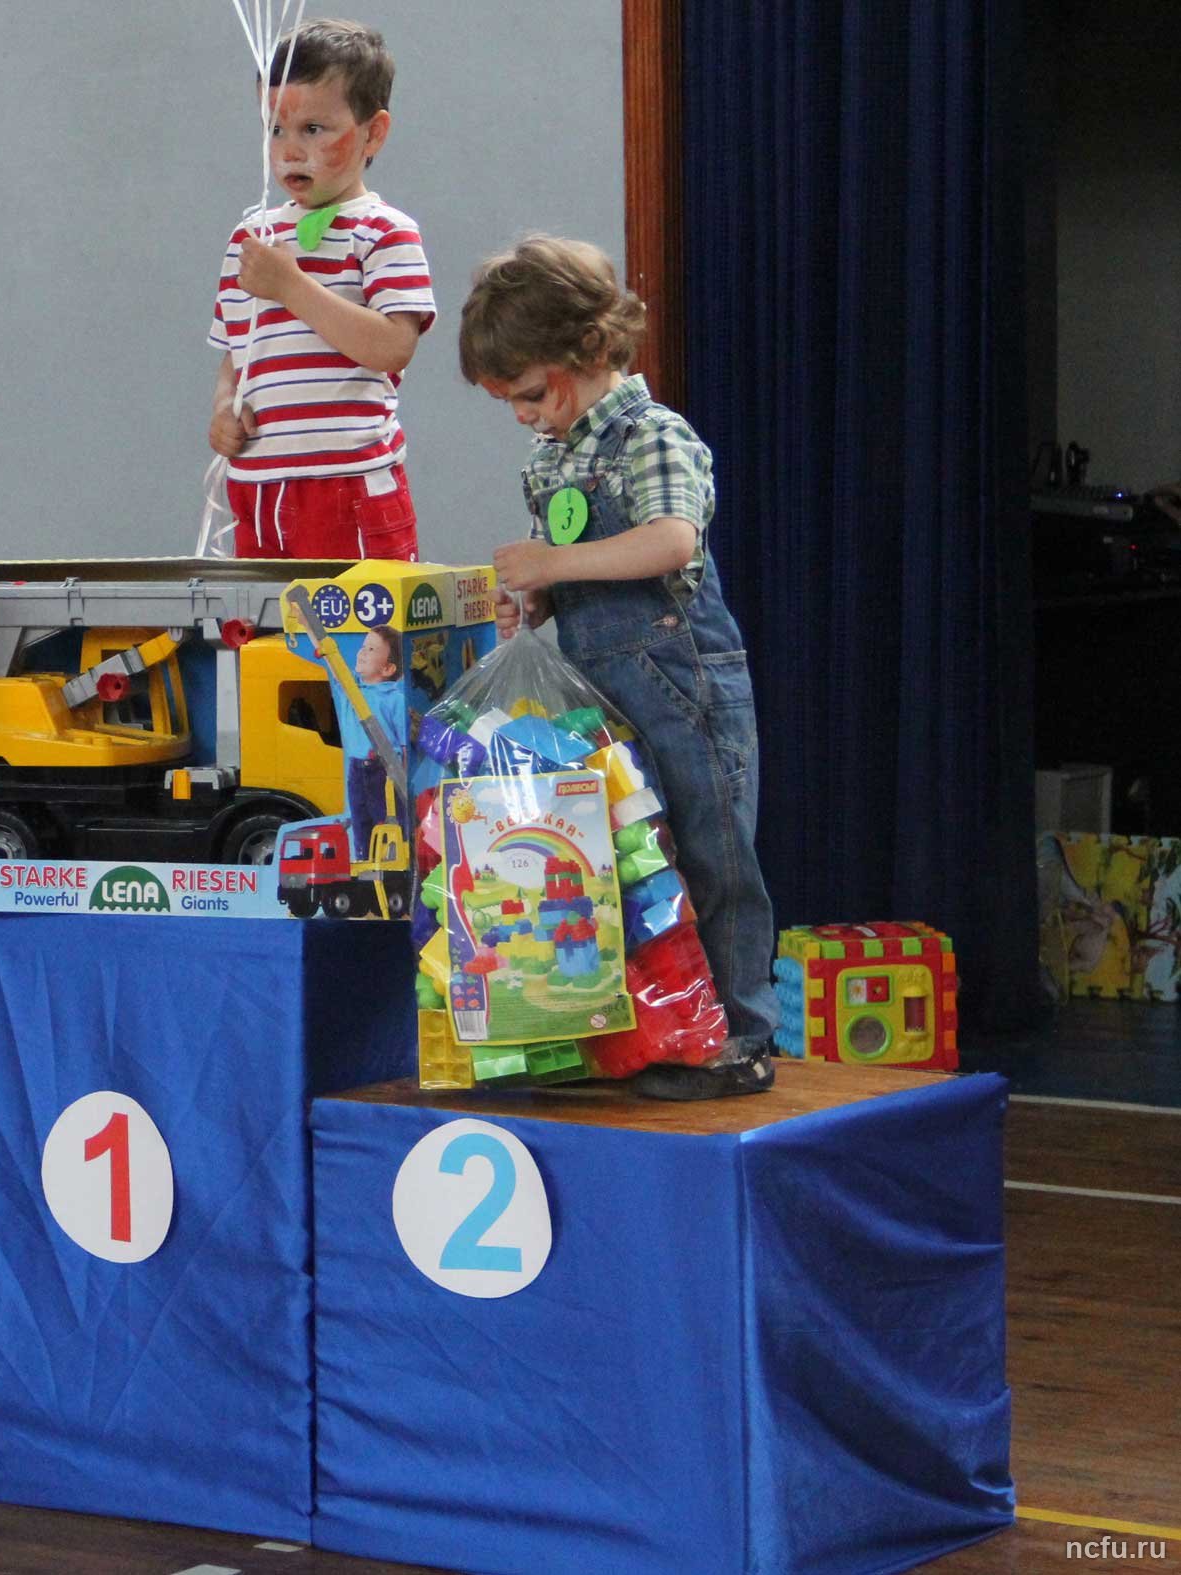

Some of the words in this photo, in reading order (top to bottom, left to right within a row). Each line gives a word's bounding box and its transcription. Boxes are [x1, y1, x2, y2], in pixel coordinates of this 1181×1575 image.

[456, 576, 488, 599] STARKE
[320, 600, 344, 616] EU
[357, 590, 394, 622] 3+
[412, 596, 439, 618] LENA
[463, 600, 492, 622] RIESEN
[0, 865, 87, 889] STARKE
[101, 880, 160, 904] LENA
[172, 869, 257, 892] RIESEN
[14, 891, 79, 907] Powerful
[181, 895, 229, 911] Giants
[83, 1112, 133, 1243] 1
[438, 1132, 523, 1272] 2
